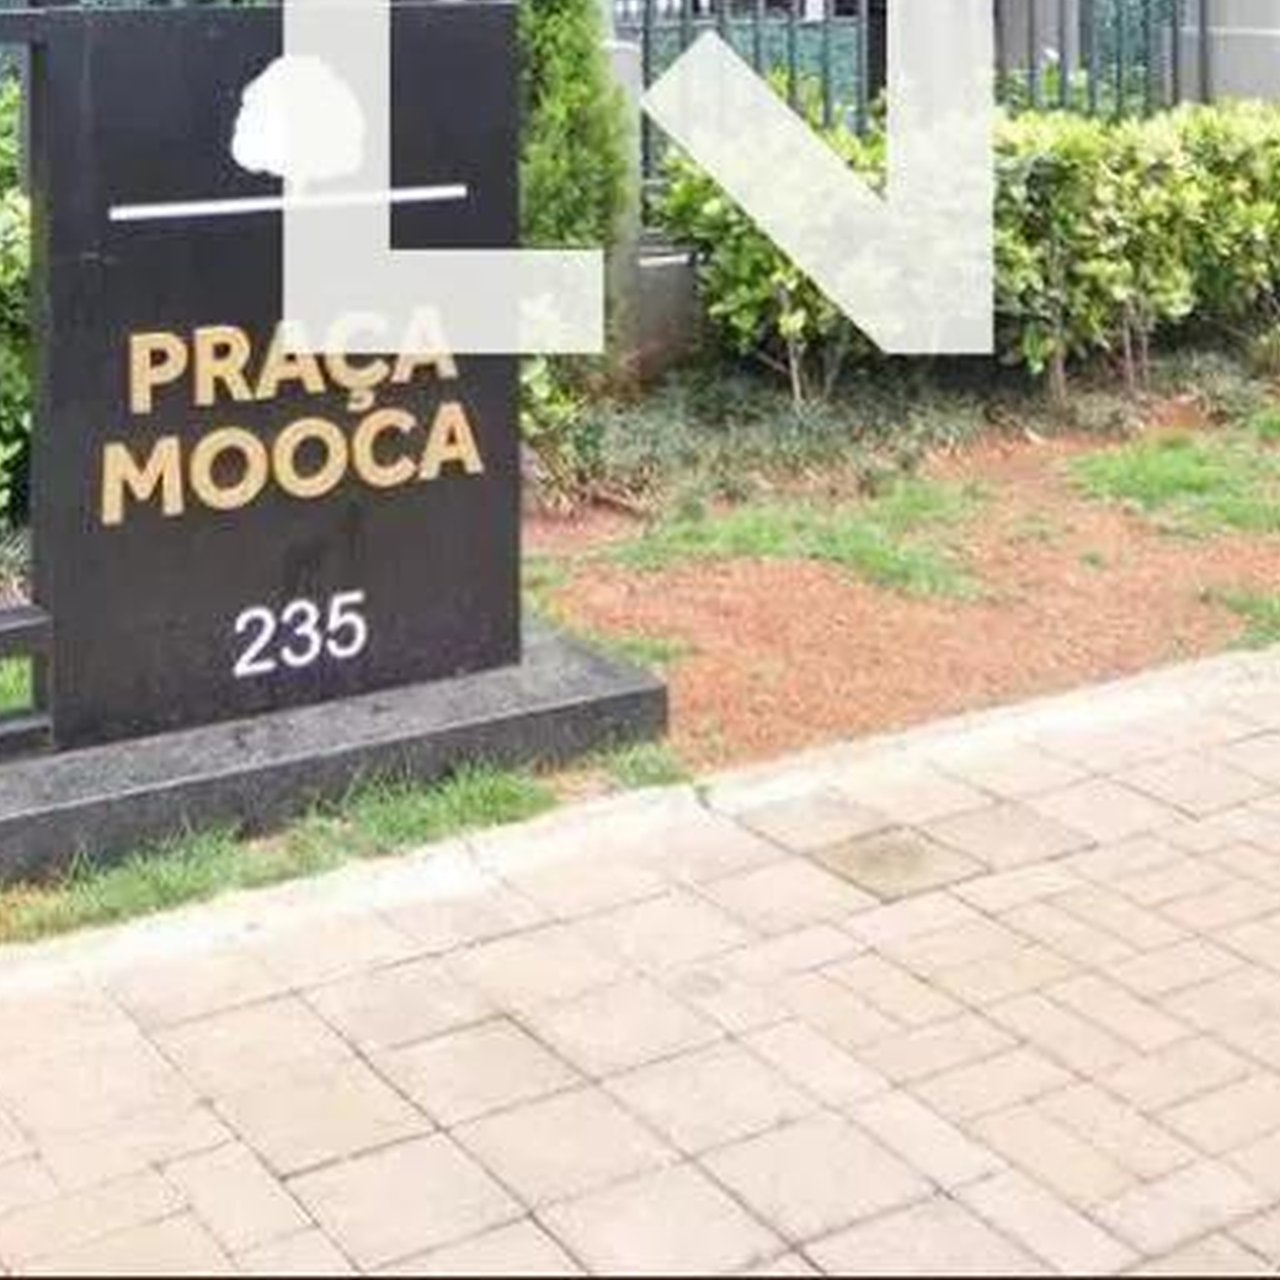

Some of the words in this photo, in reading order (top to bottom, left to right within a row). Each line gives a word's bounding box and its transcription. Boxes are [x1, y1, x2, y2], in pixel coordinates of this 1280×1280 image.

[130, 304, 458, 413] PRAÇA
[102, 402, 484, 525] MOOCA
[232, 590, 367, 677] 235
